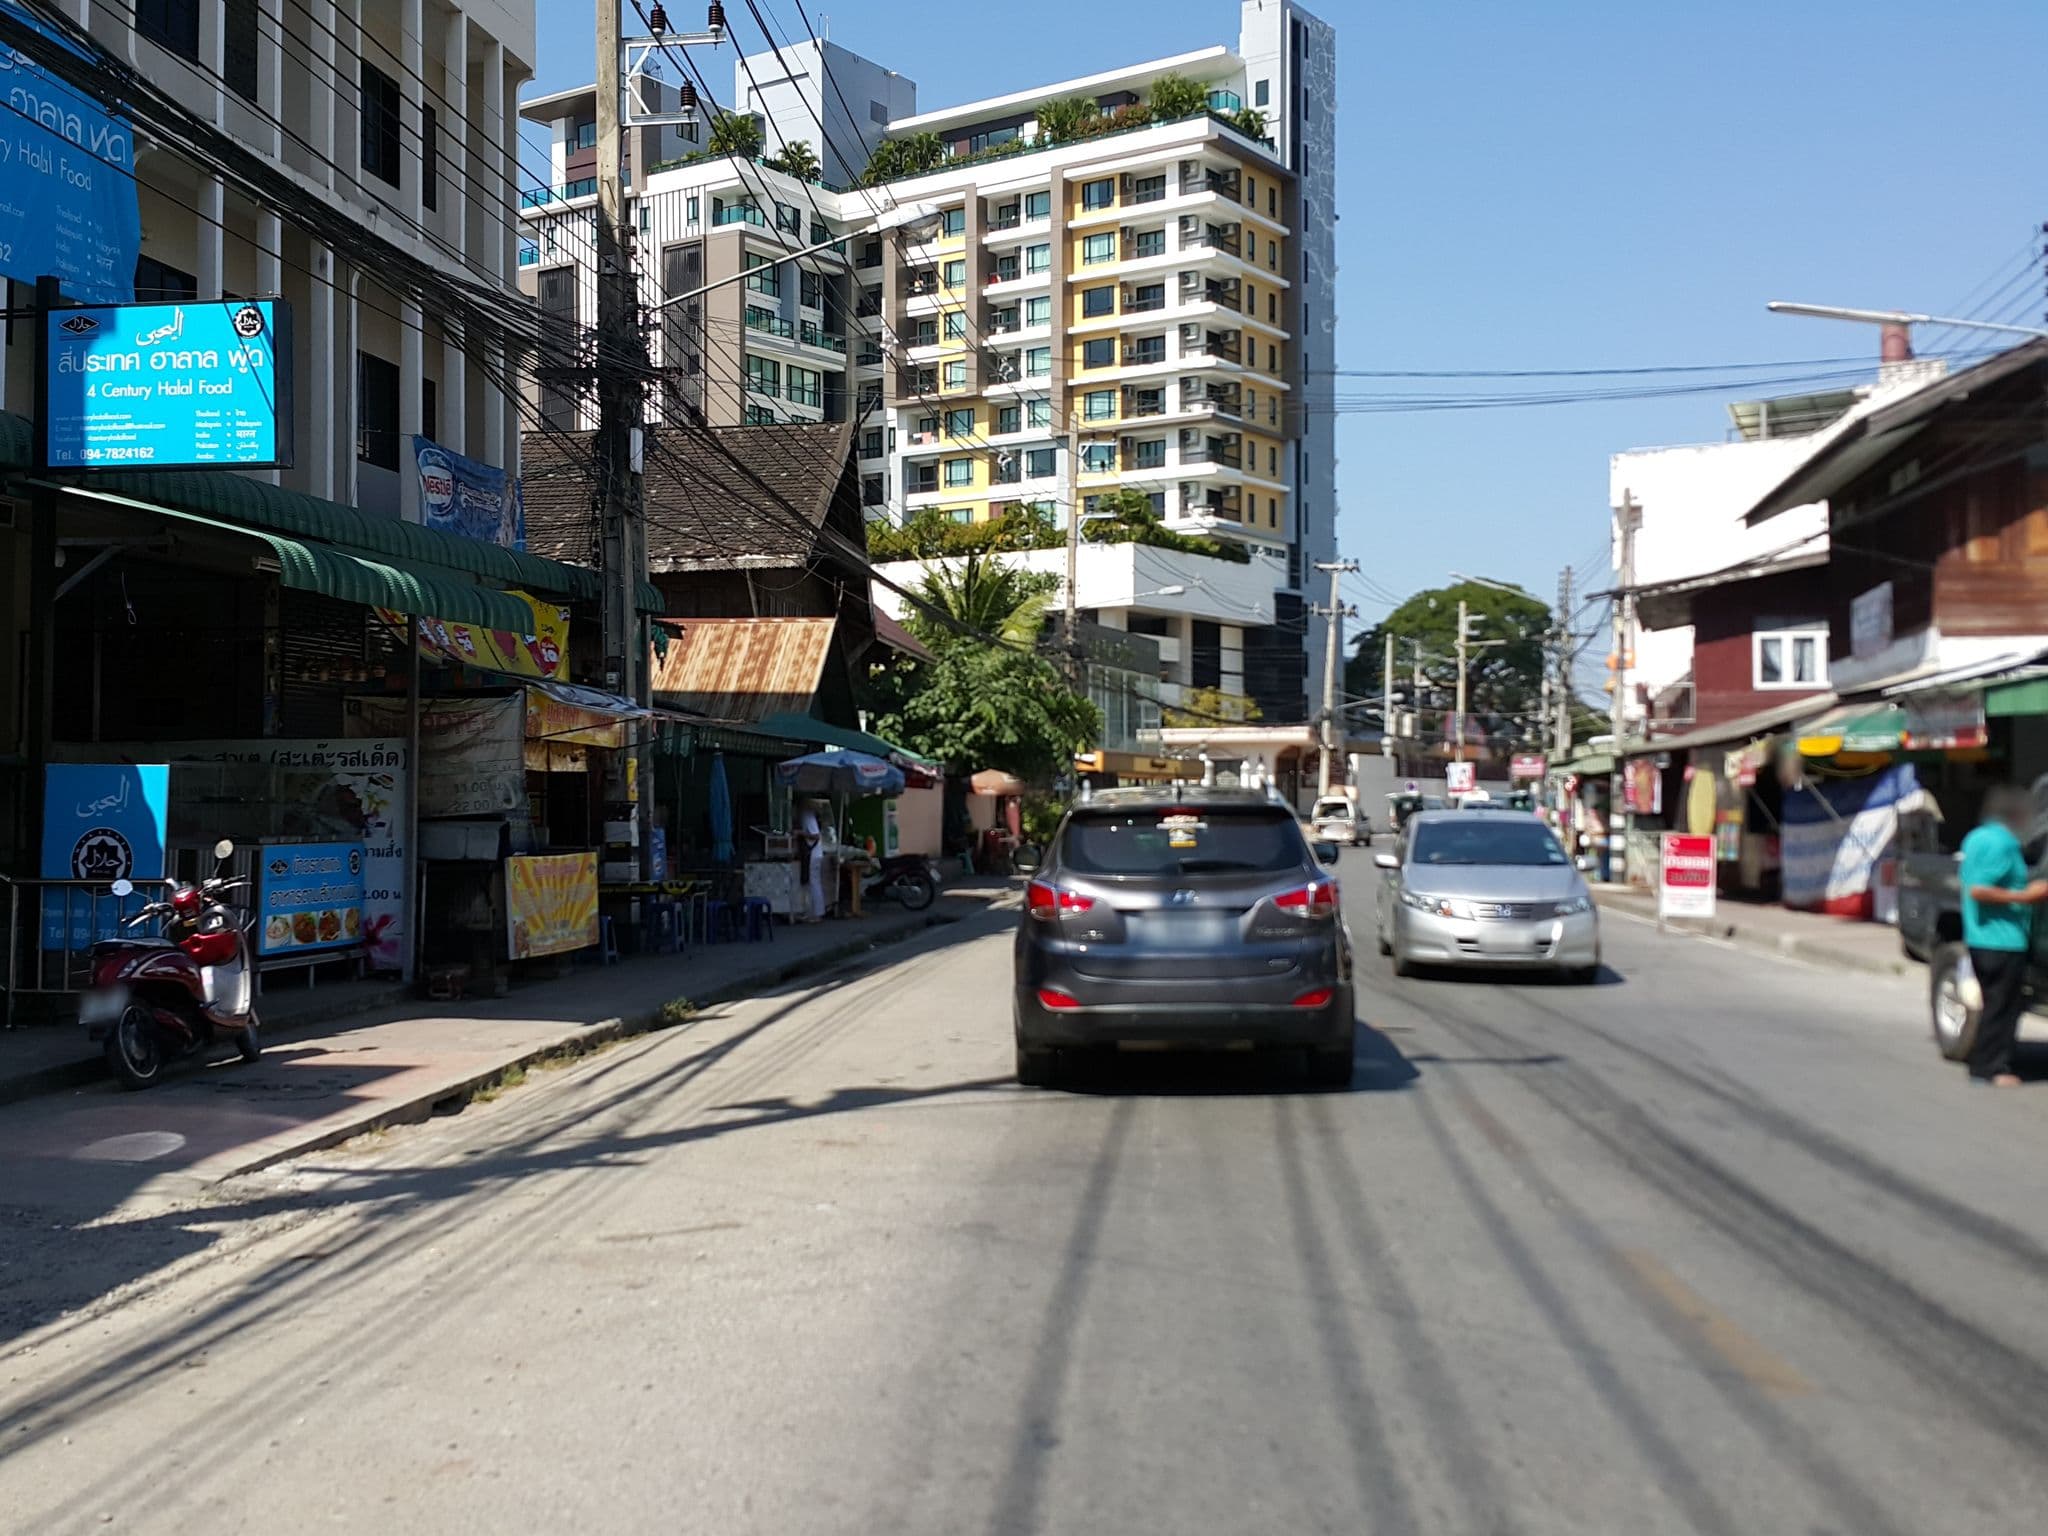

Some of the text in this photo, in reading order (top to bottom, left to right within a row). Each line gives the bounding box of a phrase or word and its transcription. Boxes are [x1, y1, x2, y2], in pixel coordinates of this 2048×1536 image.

[59, 157, 92, 191] Food
[150, 349, 219, 372] ฮาลาล
[87, 377, 233, 401] 4 Century Halal Food
[80, 446, 155, 460] 094-7824162
